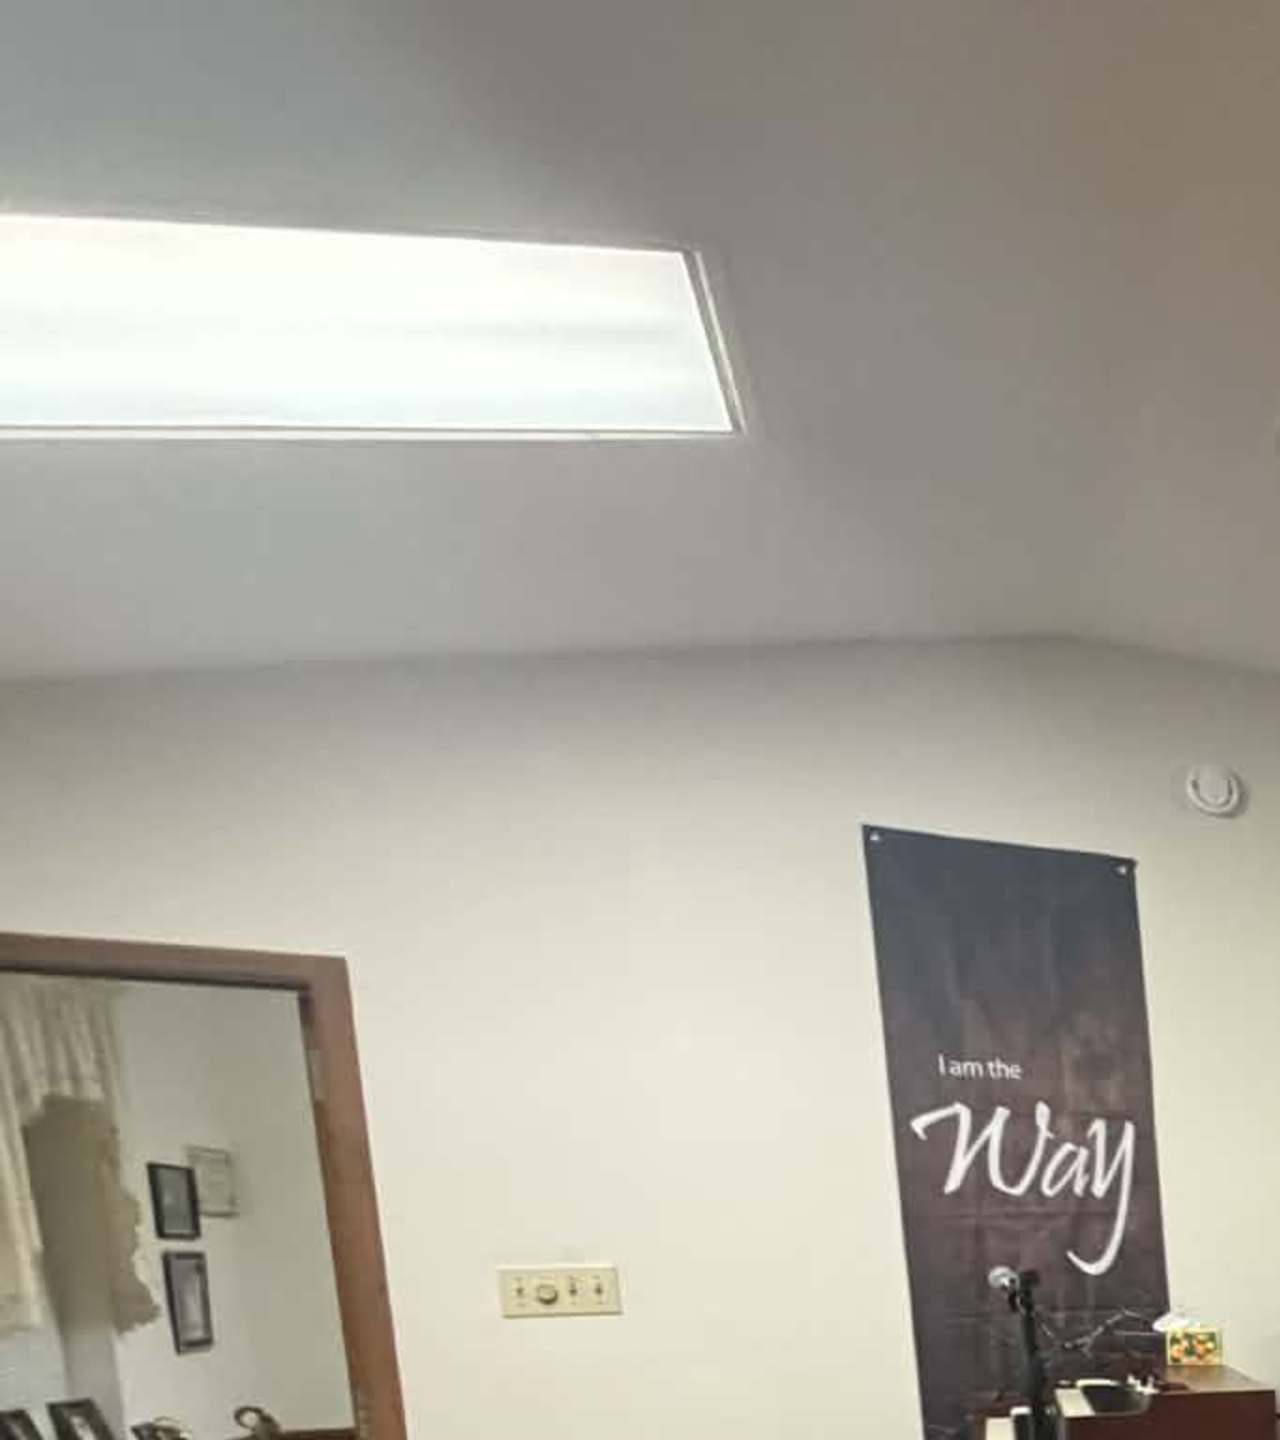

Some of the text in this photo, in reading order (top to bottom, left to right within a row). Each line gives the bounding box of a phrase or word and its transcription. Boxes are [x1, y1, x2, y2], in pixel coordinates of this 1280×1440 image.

[938, 1053, 1022, 1080] I am the
[910, 1100, 1135, 1276] Way
